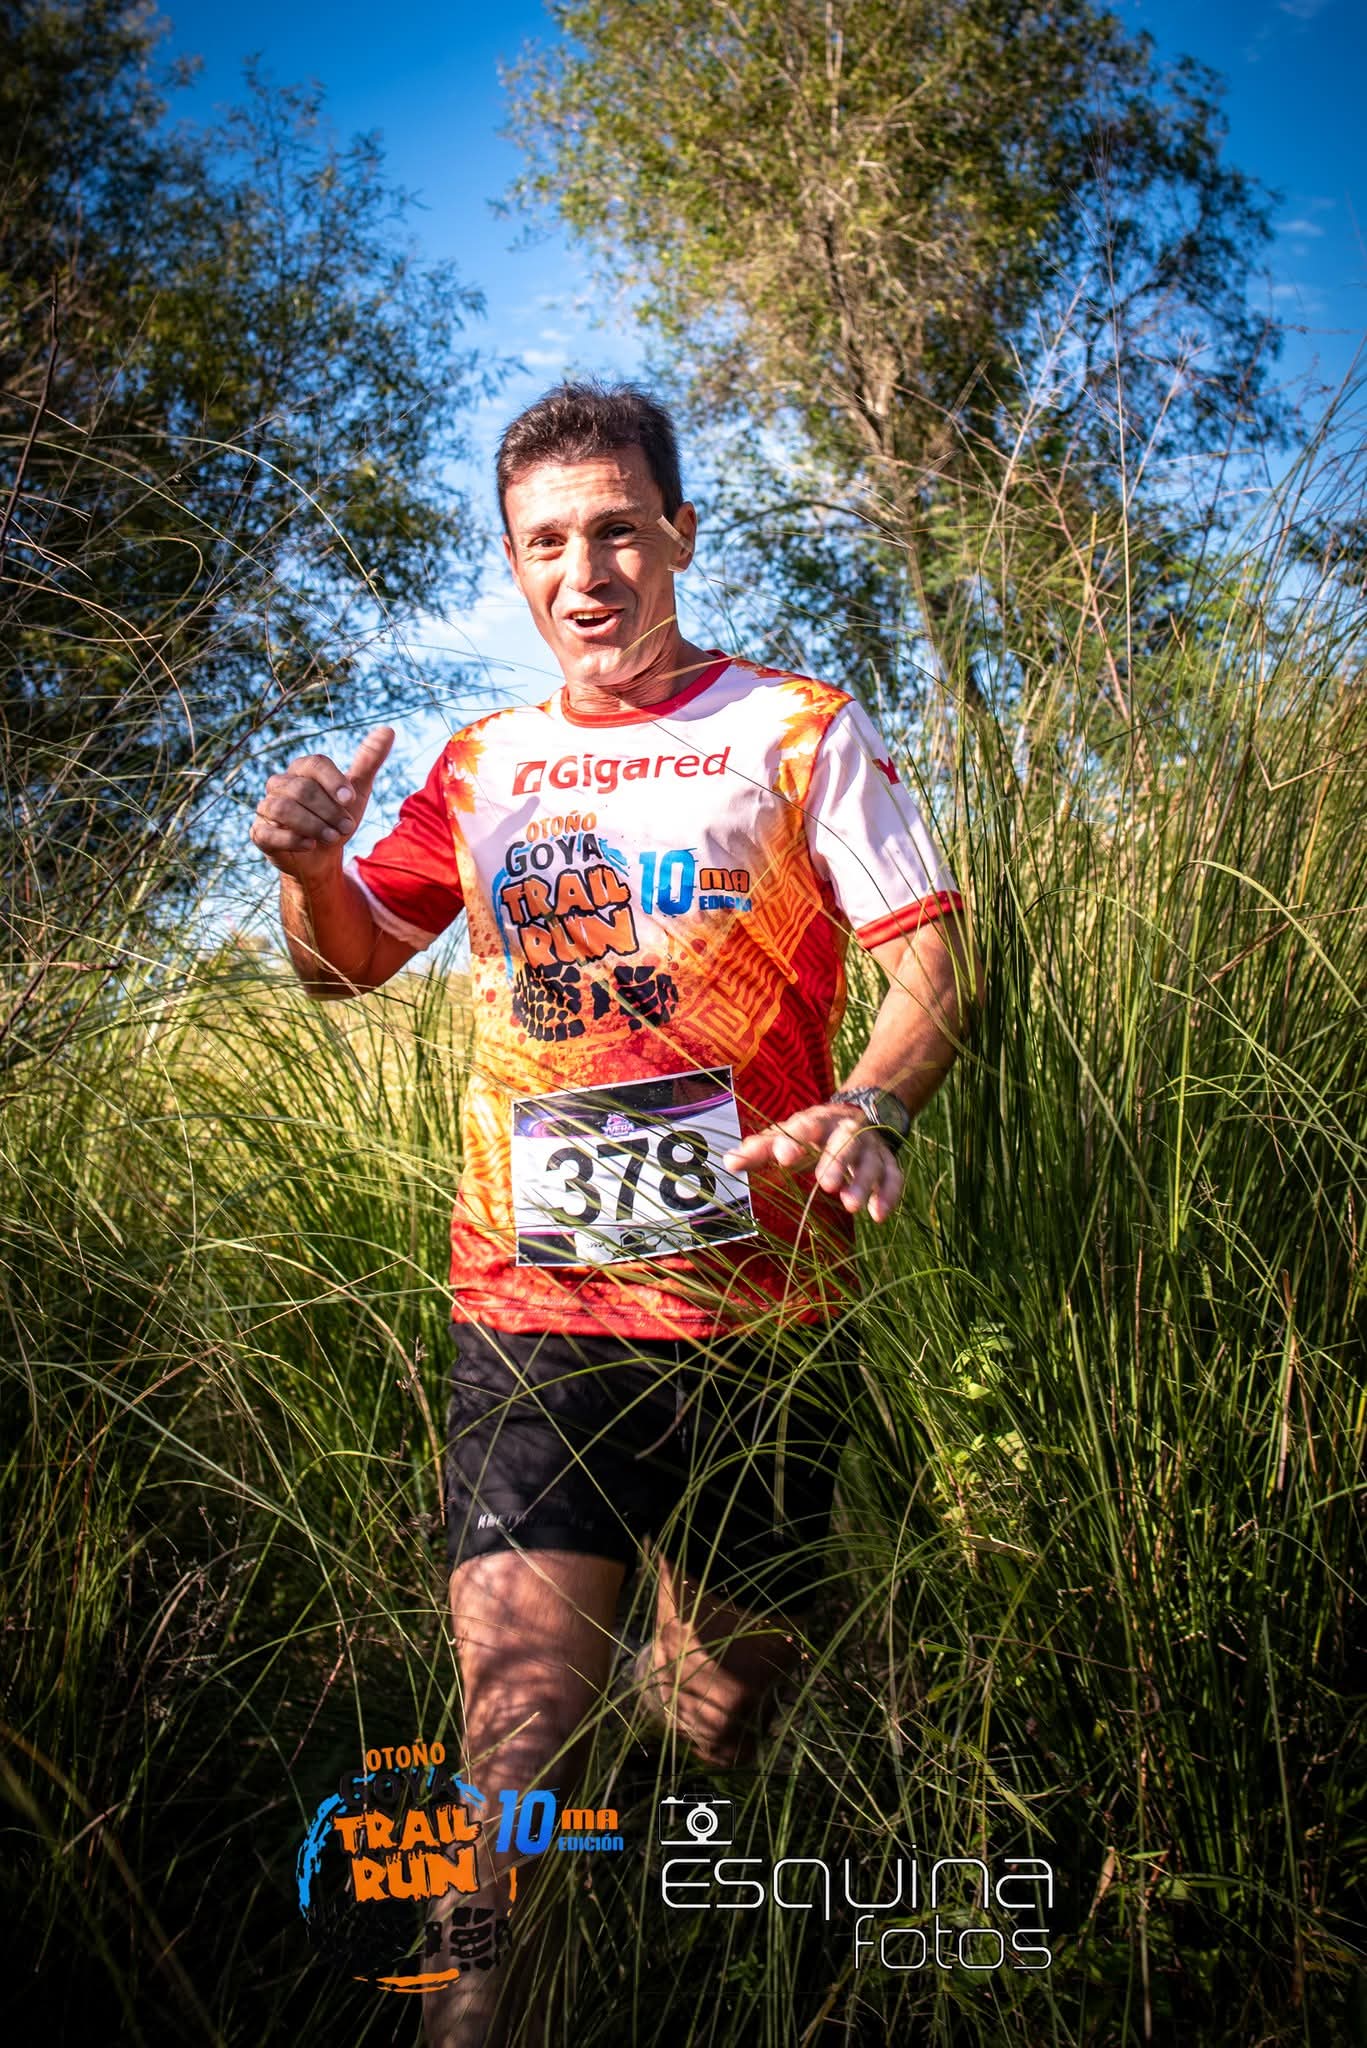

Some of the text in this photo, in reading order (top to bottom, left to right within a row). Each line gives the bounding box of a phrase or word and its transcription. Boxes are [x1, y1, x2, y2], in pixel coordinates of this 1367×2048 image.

[549, 746, 731, 794] Gigared
[506, 833, 602, 877] GOYA
[526, 810, 597, 842] OTOÑO
[501, 864, 631, 925] TRAIL
[639, 848, 697, 917] 10
[518, 904, 639, 968] RUN
[546, 1130, 716, 1226] 378
